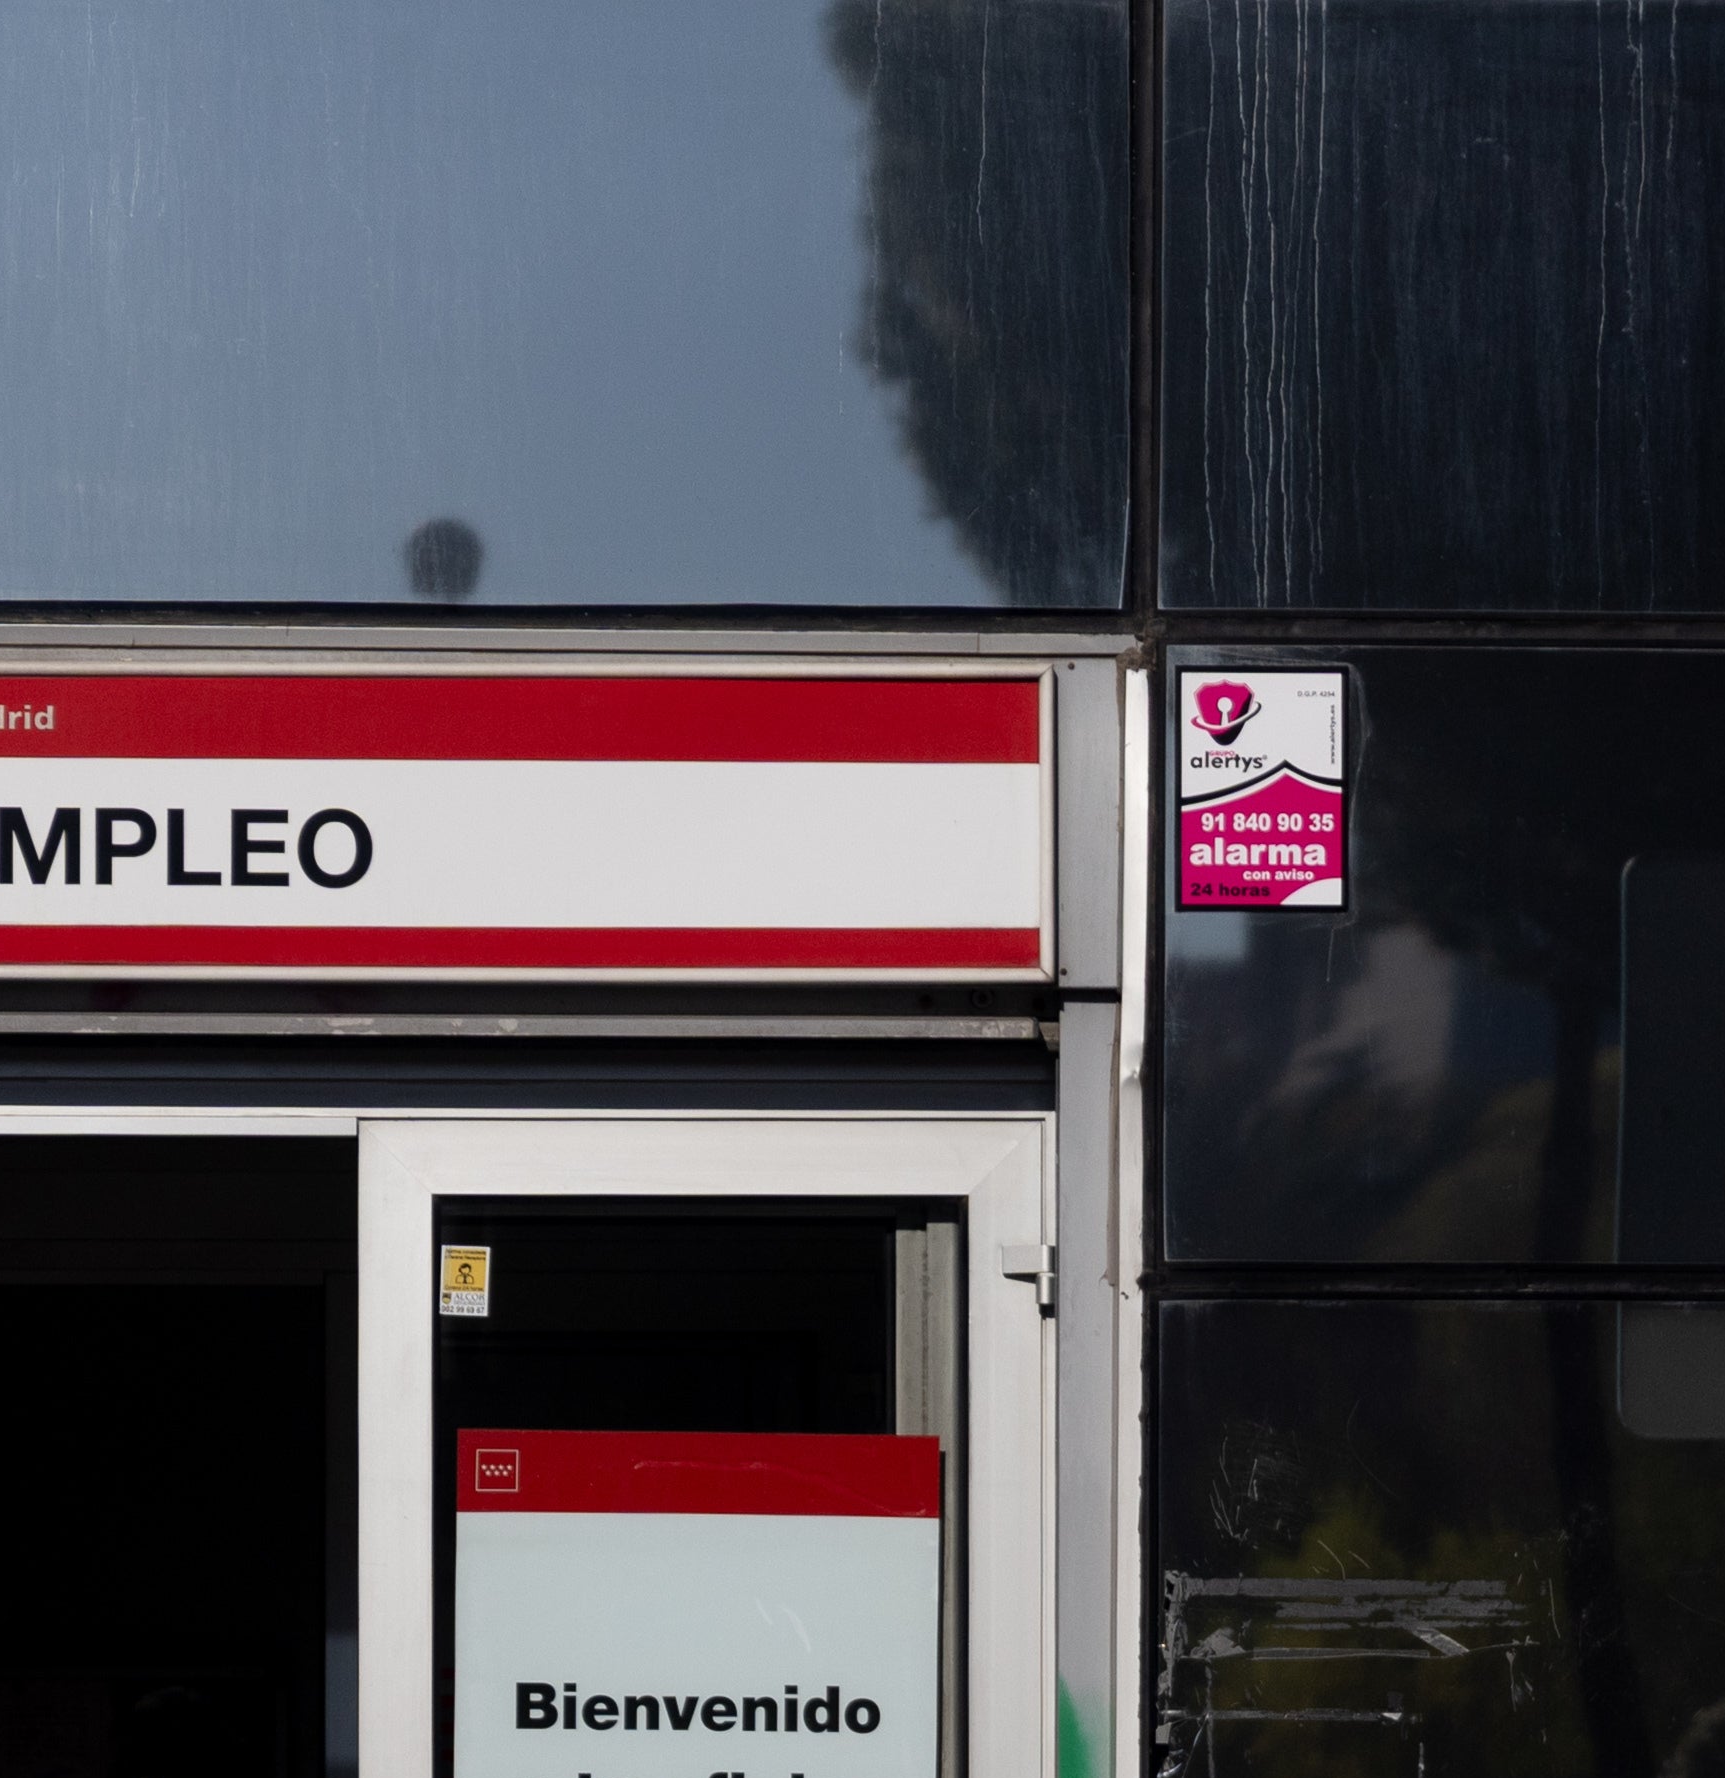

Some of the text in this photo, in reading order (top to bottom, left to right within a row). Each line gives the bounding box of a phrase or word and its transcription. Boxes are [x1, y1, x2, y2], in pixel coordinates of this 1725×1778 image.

[1201, 813, 1334, 831] 91 840 90 35
[1190, 837, 1326, 866] alarma
[1243, 869, 1314, 881] con aviso
[1190, 883, 1270, 897] 24 horas
[516, 1683, 880, 1734] Bienvenido
